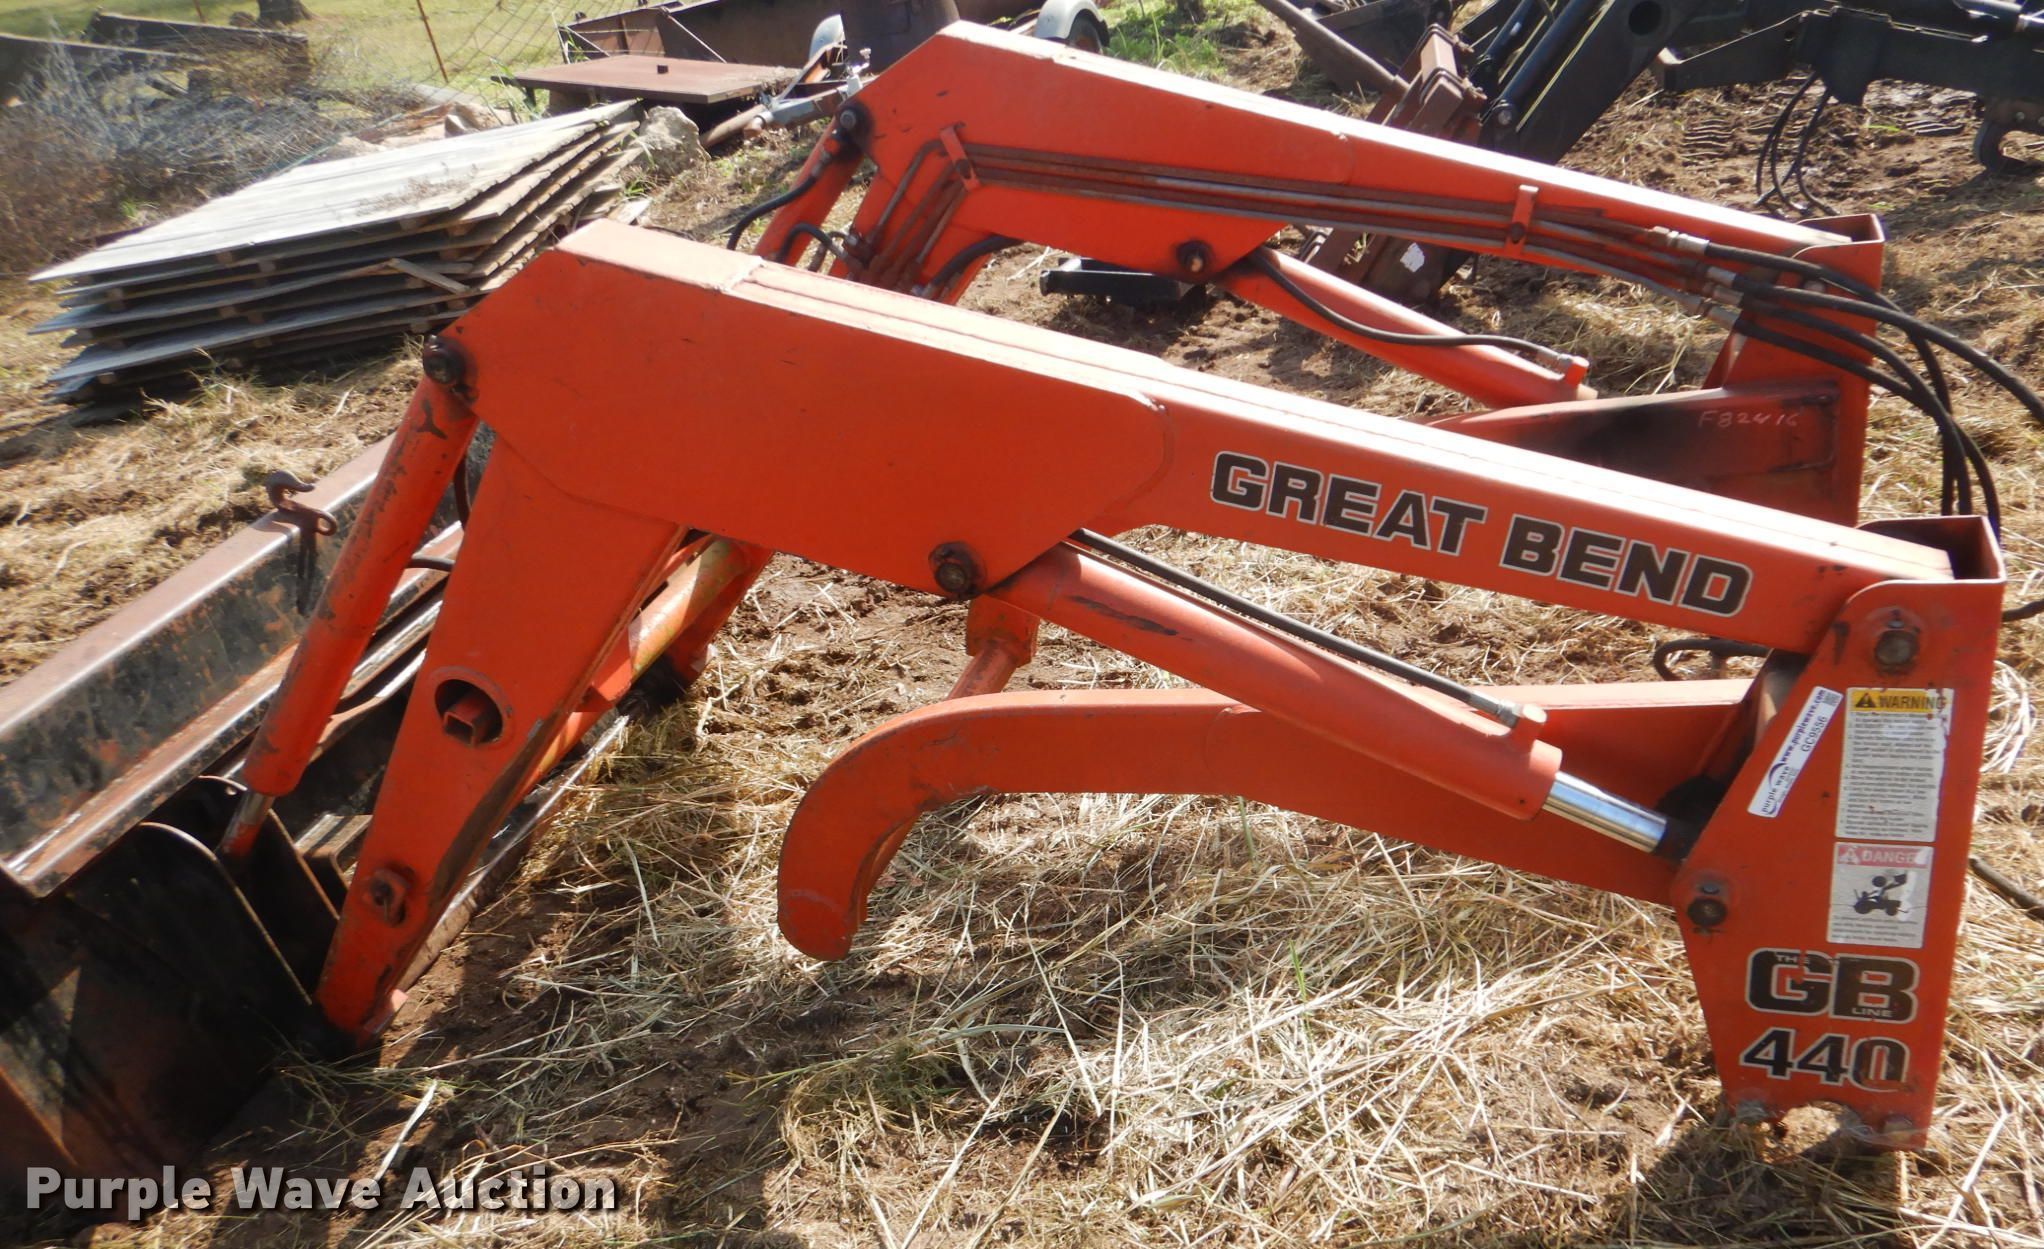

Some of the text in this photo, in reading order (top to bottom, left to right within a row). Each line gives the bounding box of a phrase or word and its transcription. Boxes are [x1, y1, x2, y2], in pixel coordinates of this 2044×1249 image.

[1210, 451, 1753, 618] GREAT BEND
[1780, 689, 1826, 763] www.purplewave.com
[1878, 694, 1947, 710] WARNING
[1801, 716, 1827, 752] GC9556
[1761, 788, 1777, 815] purple
[1775, 766, 1790, 786] wave
[1861, 849, 1922, 865] DANGE
[1745, 947, 1920, 1024] GB
[1852, 1007, 1892, 1018] LINE
[1739, 1027, 1910, 1093] 440
